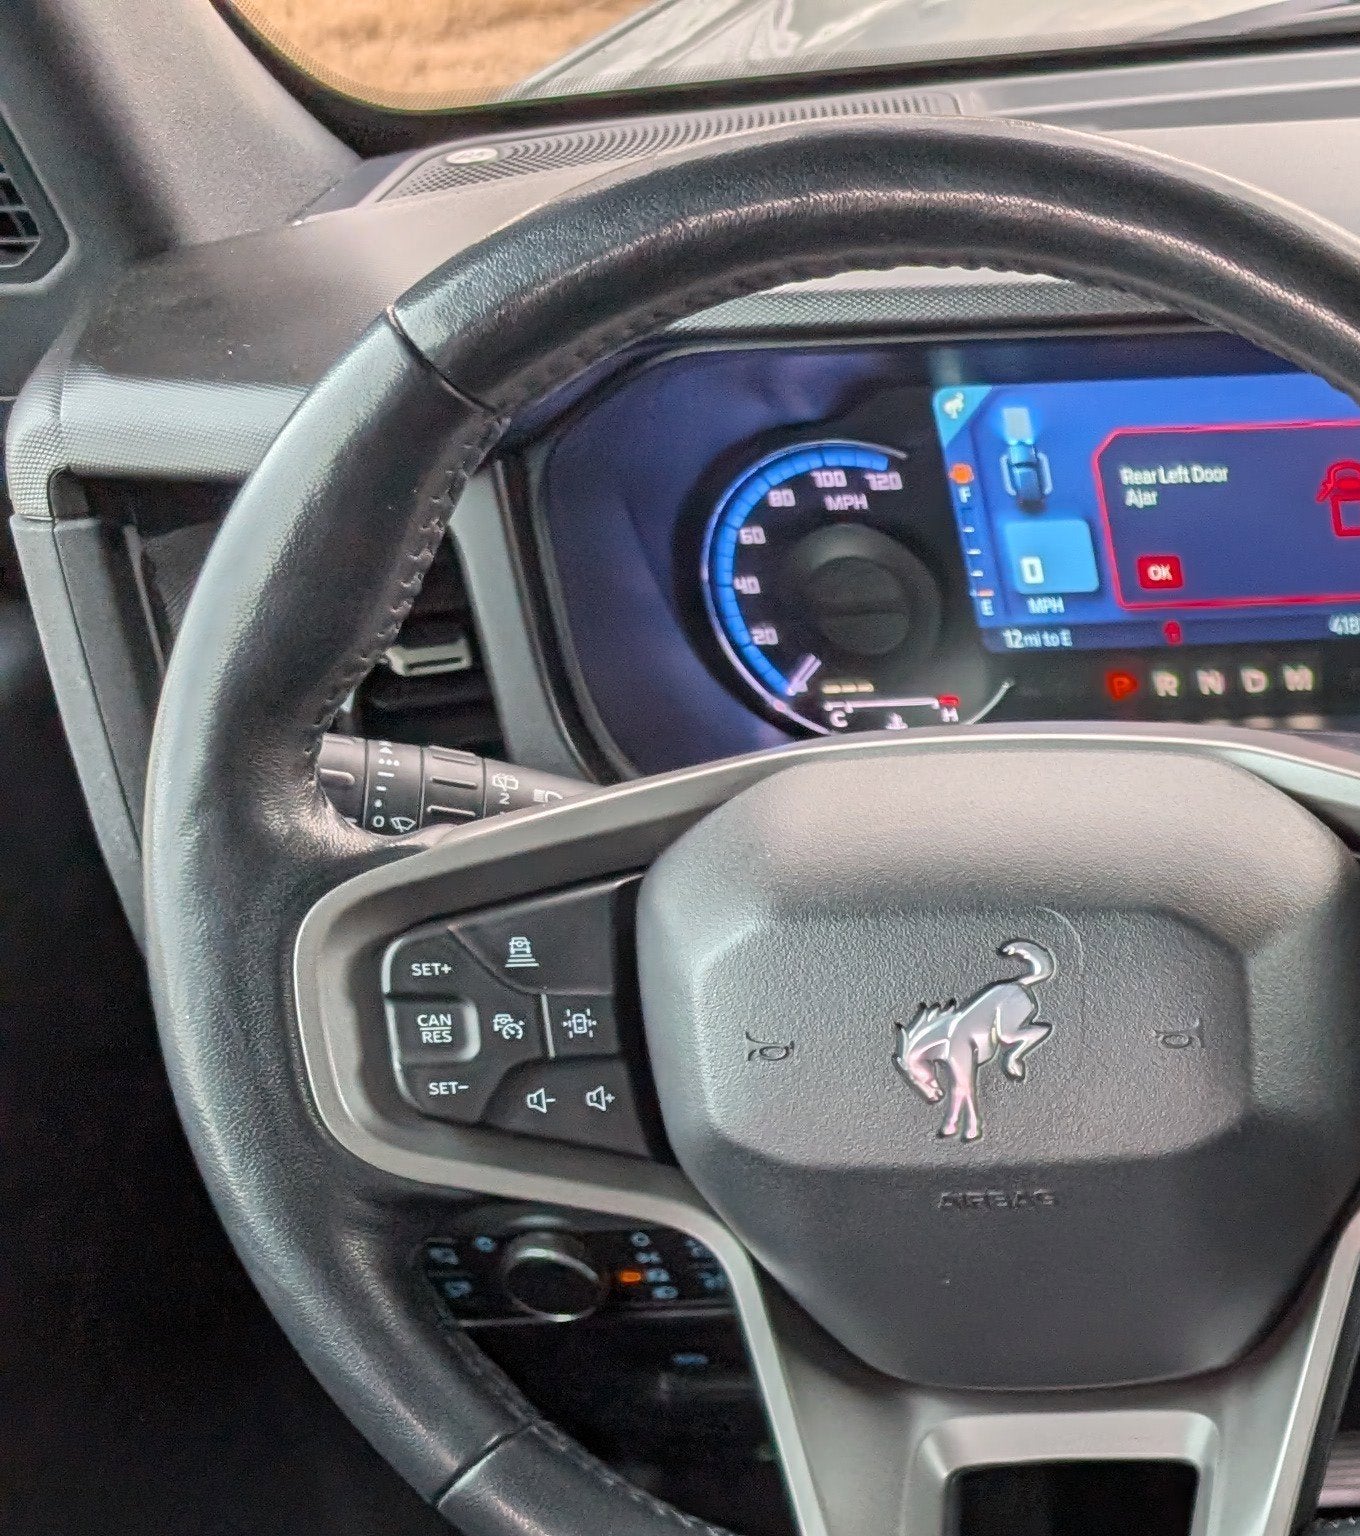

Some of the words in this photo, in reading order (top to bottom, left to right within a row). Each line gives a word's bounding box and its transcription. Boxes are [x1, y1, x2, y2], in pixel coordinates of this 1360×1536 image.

[811, 470, 847, 488] 100
[865, 471, 902, 491] 120
[1120, 466, 1157, 485] Rear
[1158, 465, 1191, 484] Left
[1190, 465, 1228, 483] Door
[768, 489, 796, 508] 80
[823, 493, 868, 510] MPH
[959, 487, 972, 503] F
[1125, 488, 1157, 508] Ajar
[739, 526, 766, 544] 60
[1020, 556, 1044, 584] 0
[1147, 565, 1173, 581] OK
[734, 576, 761, 594] 40
[980, 599, 994, 616] E
[1027, 597, 1065, 614] MPH
[751, 627, 779, 645] 20
[1061, 629, 1077, 647] E
[1109, 672, 1137, 699] P
[1152, 671, 1179, 697] R
[1197, 669, 1225, 695] N
[1241, 668, 1268, 693] D
[1283, 665, 1314, 691] M
[829, 711, 848, 727] C
[940, 707, 959, 722] H
[411, 962, 452, 977] SET+
[417, 1014, 452, 1029] CAN
[421, 1030, 453, 1044] RES
